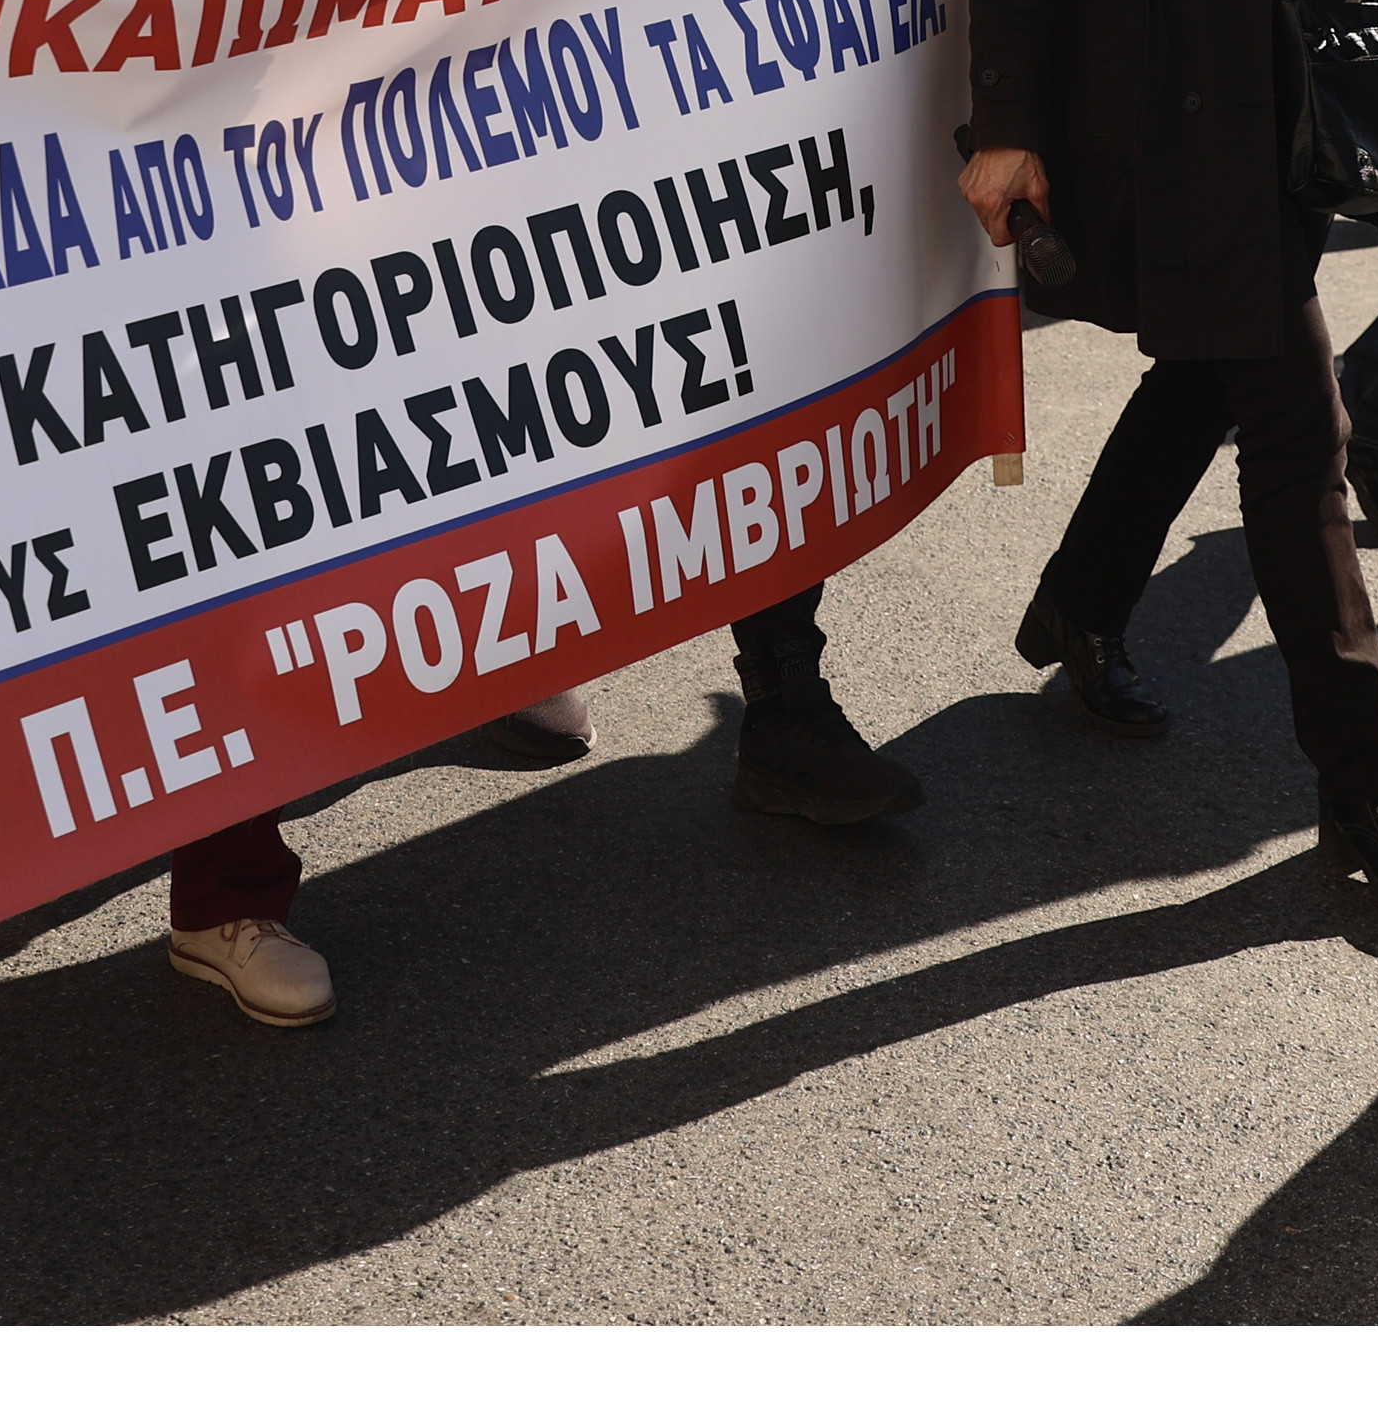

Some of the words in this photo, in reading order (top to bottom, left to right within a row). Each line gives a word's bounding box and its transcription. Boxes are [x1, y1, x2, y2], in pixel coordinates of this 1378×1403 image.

[108, 133, 216, 261] ΑΠΟ
[223, 113, 325, 228] ΤΟΥ
[340, 6, 640, 201] ΠΟΛΕΜΟΥ
[643, 14, 733, 119] ΤΑ
[113, 299, 755, 592] ΕΚΒΙΑΣΜΟΥΣ!
[20, 658, 256, 839] Π.Ε.
[265, 534, 602, 726] "ΡΟΖΑ
[618, 347, 957, 615] ΙΜΒΡΙΩΤΗ"
